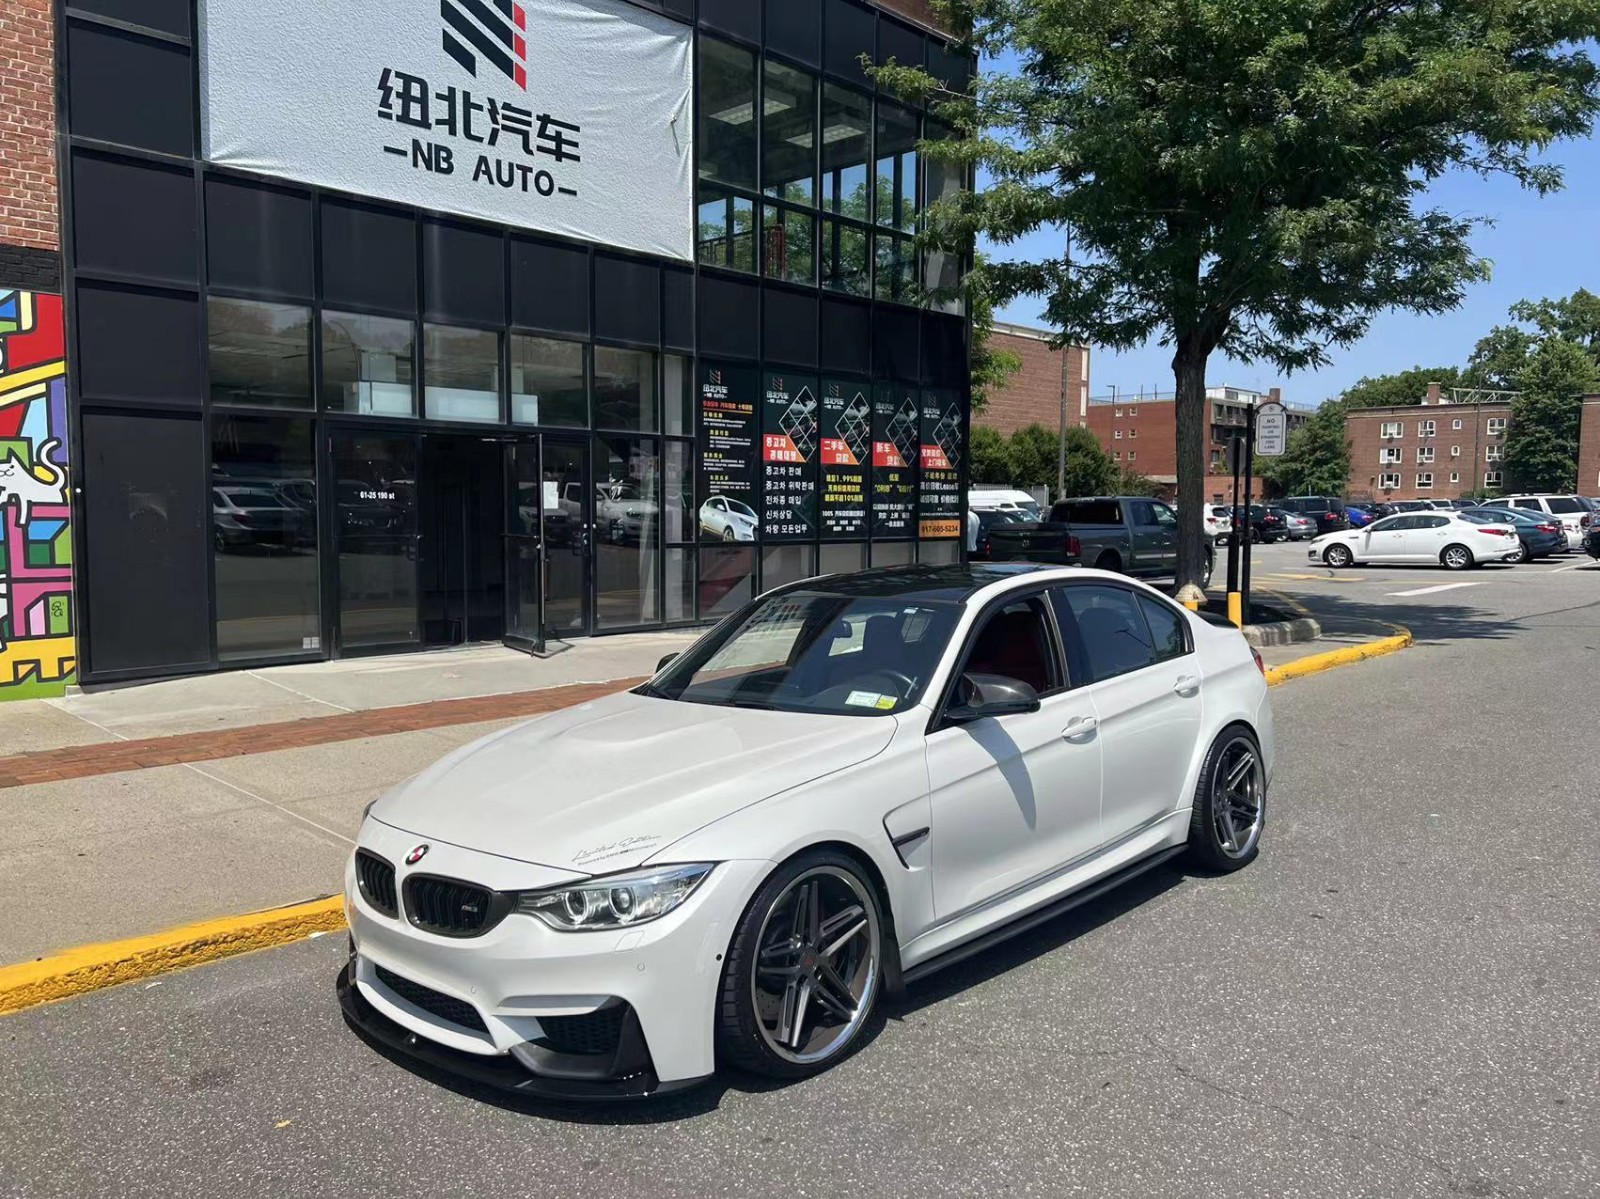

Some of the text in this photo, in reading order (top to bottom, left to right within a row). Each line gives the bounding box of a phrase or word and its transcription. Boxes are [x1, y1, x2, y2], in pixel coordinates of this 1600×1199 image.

[377, 67, 581, 163] 纽北汽车
[411, 138, 555, 197] NB AUTO
[766, 436, 786, 448] 중고차
[824, 440, 844, 451] 二手车
[766, 465, 802, 476] 중고차 판매
[766, 480, 814, 491] 중고차 위탁판매
[360, 490, 377, 499] 61-25
[765, 495, 802, 505] 전차종 매입
[765, 510, 793, 520] 신차상담
[765, 523, 808, 534] 차량 모든업무
